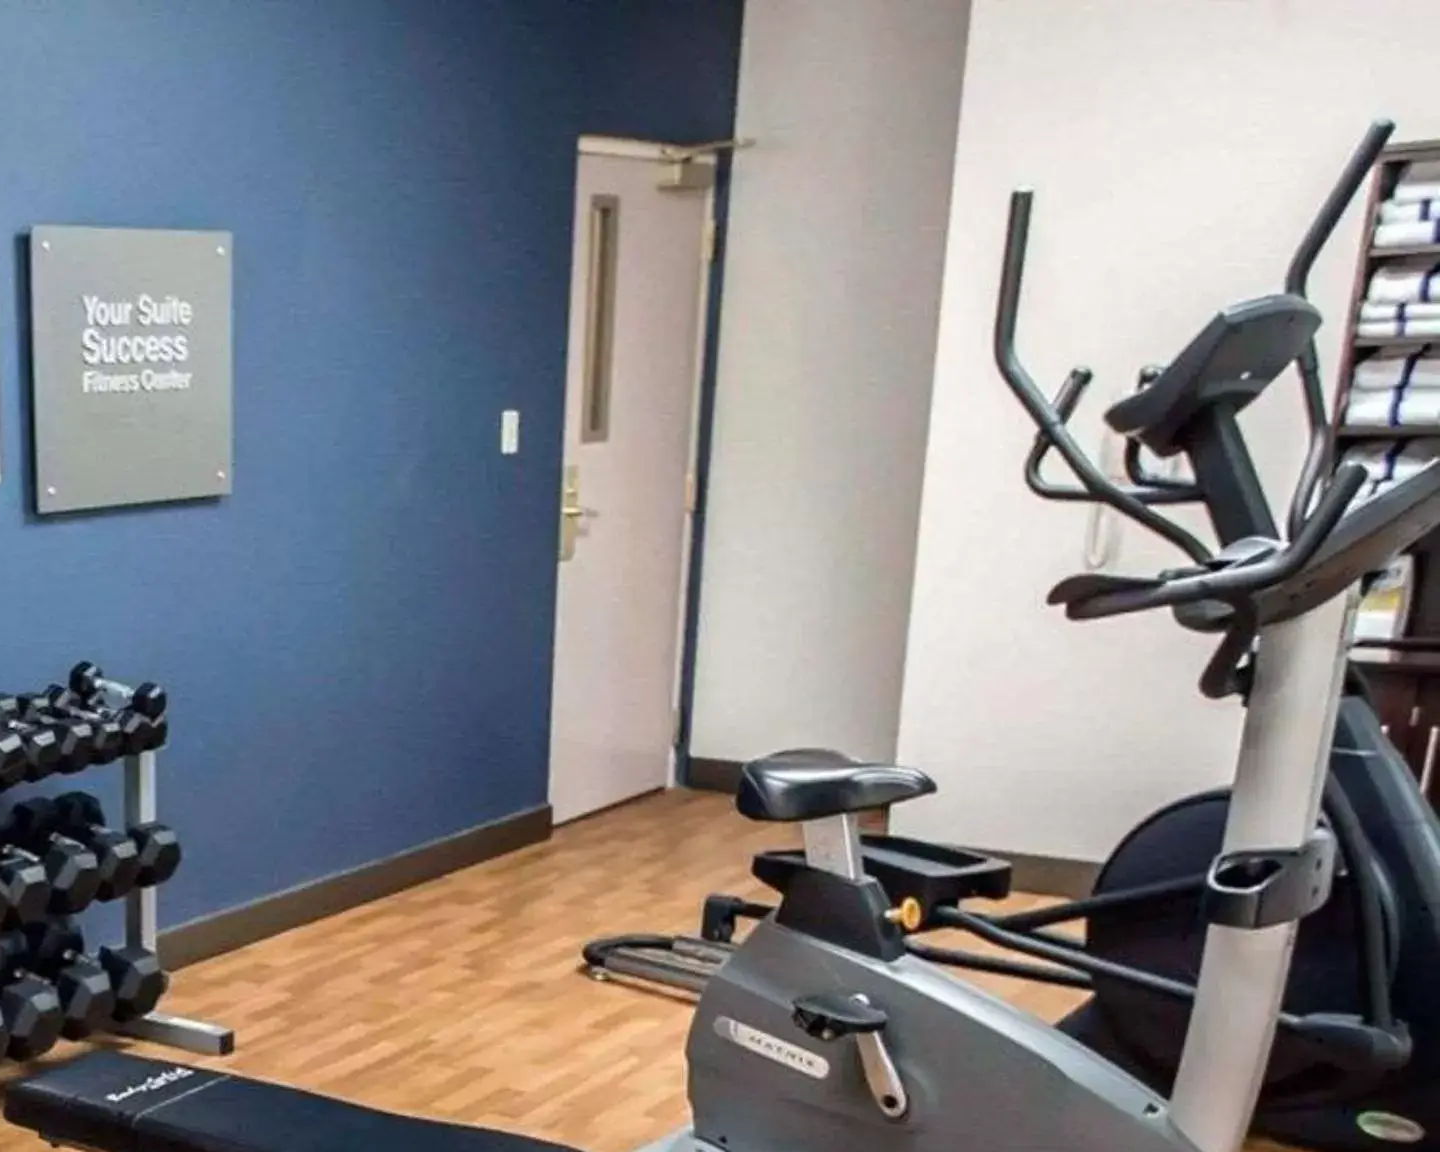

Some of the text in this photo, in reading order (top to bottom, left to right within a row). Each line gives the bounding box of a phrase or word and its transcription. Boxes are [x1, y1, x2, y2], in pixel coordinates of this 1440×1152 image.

[81, 293, 193, 327] Your Suite
[81, 328, 189, 365] Success
